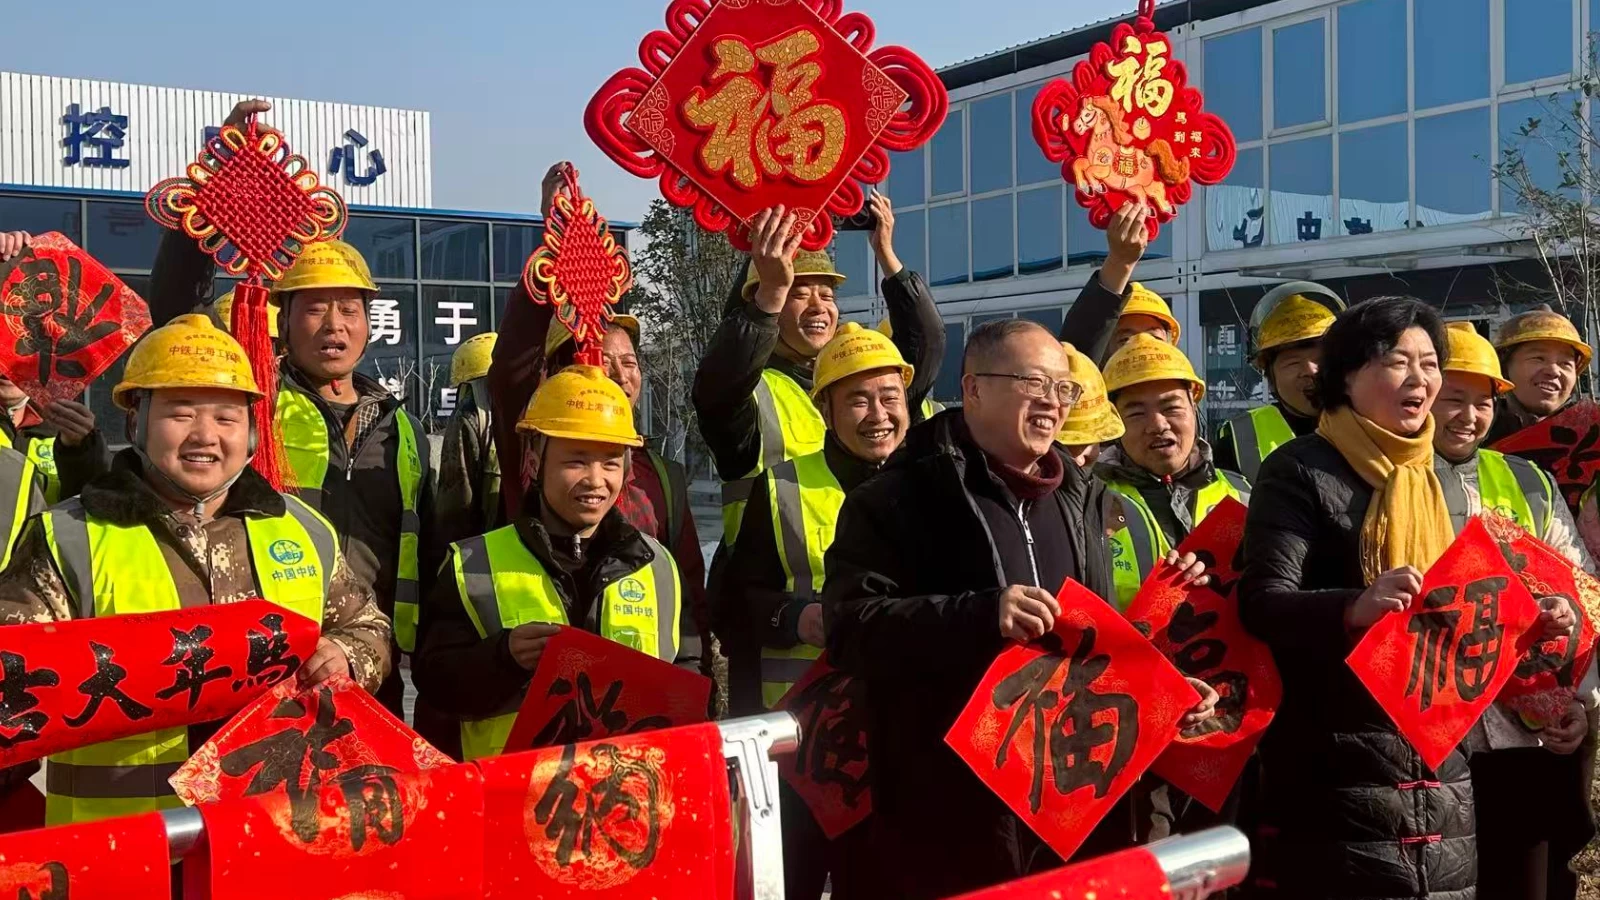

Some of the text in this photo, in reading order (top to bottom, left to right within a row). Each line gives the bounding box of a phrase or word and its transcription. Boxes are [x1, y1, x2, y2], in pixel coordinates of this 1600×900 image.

[684, 29, 848, 189] 福
[1107, 35, 1174, 118] 福
[272, 564, 317, 582] 中国中铁
[613, 603, 654, 619] 中国中铁
[1405, 576, 1509, 713] 福
[992, 624, 1141, 815] 福
